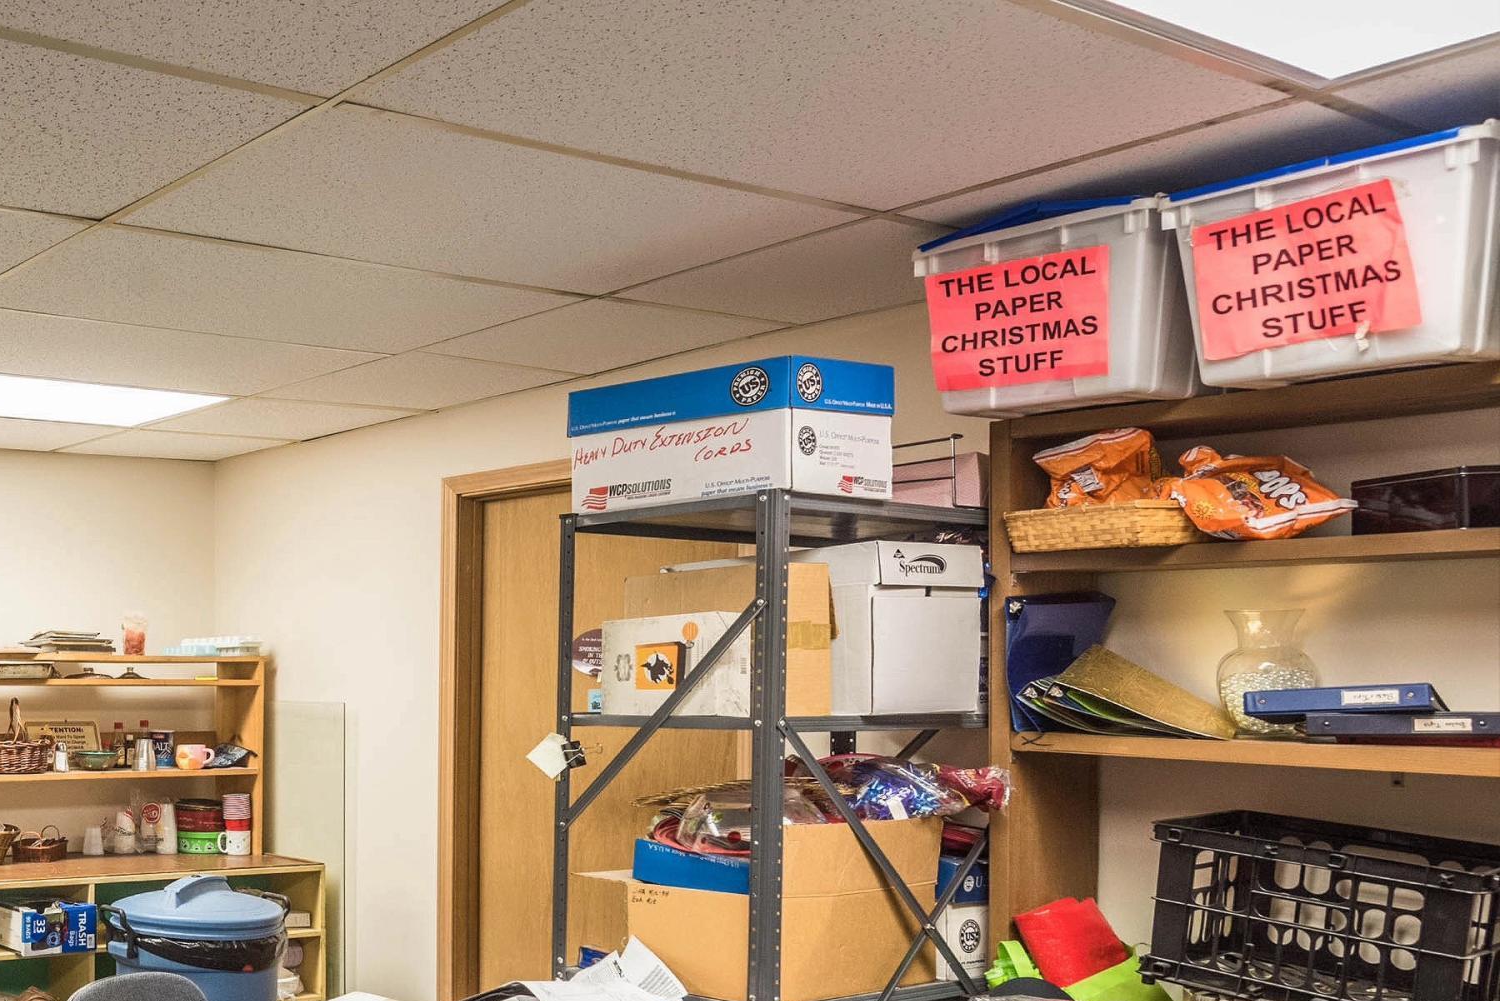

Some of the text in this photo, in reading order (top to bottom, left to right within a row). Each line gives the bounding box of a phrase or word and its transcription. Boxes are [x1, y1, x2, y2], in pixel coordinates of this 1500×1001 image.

[1209, 193, 1386, 251] THE LOCAL
[1252, 235, 1357, 274] PAPER
[939, 257, 1096, 298] THE LOCAL
[1211, 259, 1402, 315] CHRISTMAS
[974, 291, 1063, 320] PAPER
[1261, 301, 1368, 338] STUFF
[941, 315, 1099, 353] CHRISTMAS
[978, 350, 1064, 377] STUFF
[739, 378, 760, 395] US
[803, 376, 816, 390] US
[574, 418, 749, 470] HEAVY DUTY EXTENSION
[694, 438, 753, 462] CORDS
[899, 561, 940, 577] Spectrum
[37, 919, 45, 933] 33
[78, 911, 87, 946] TRASH
[965, 932, 975, 941] US
